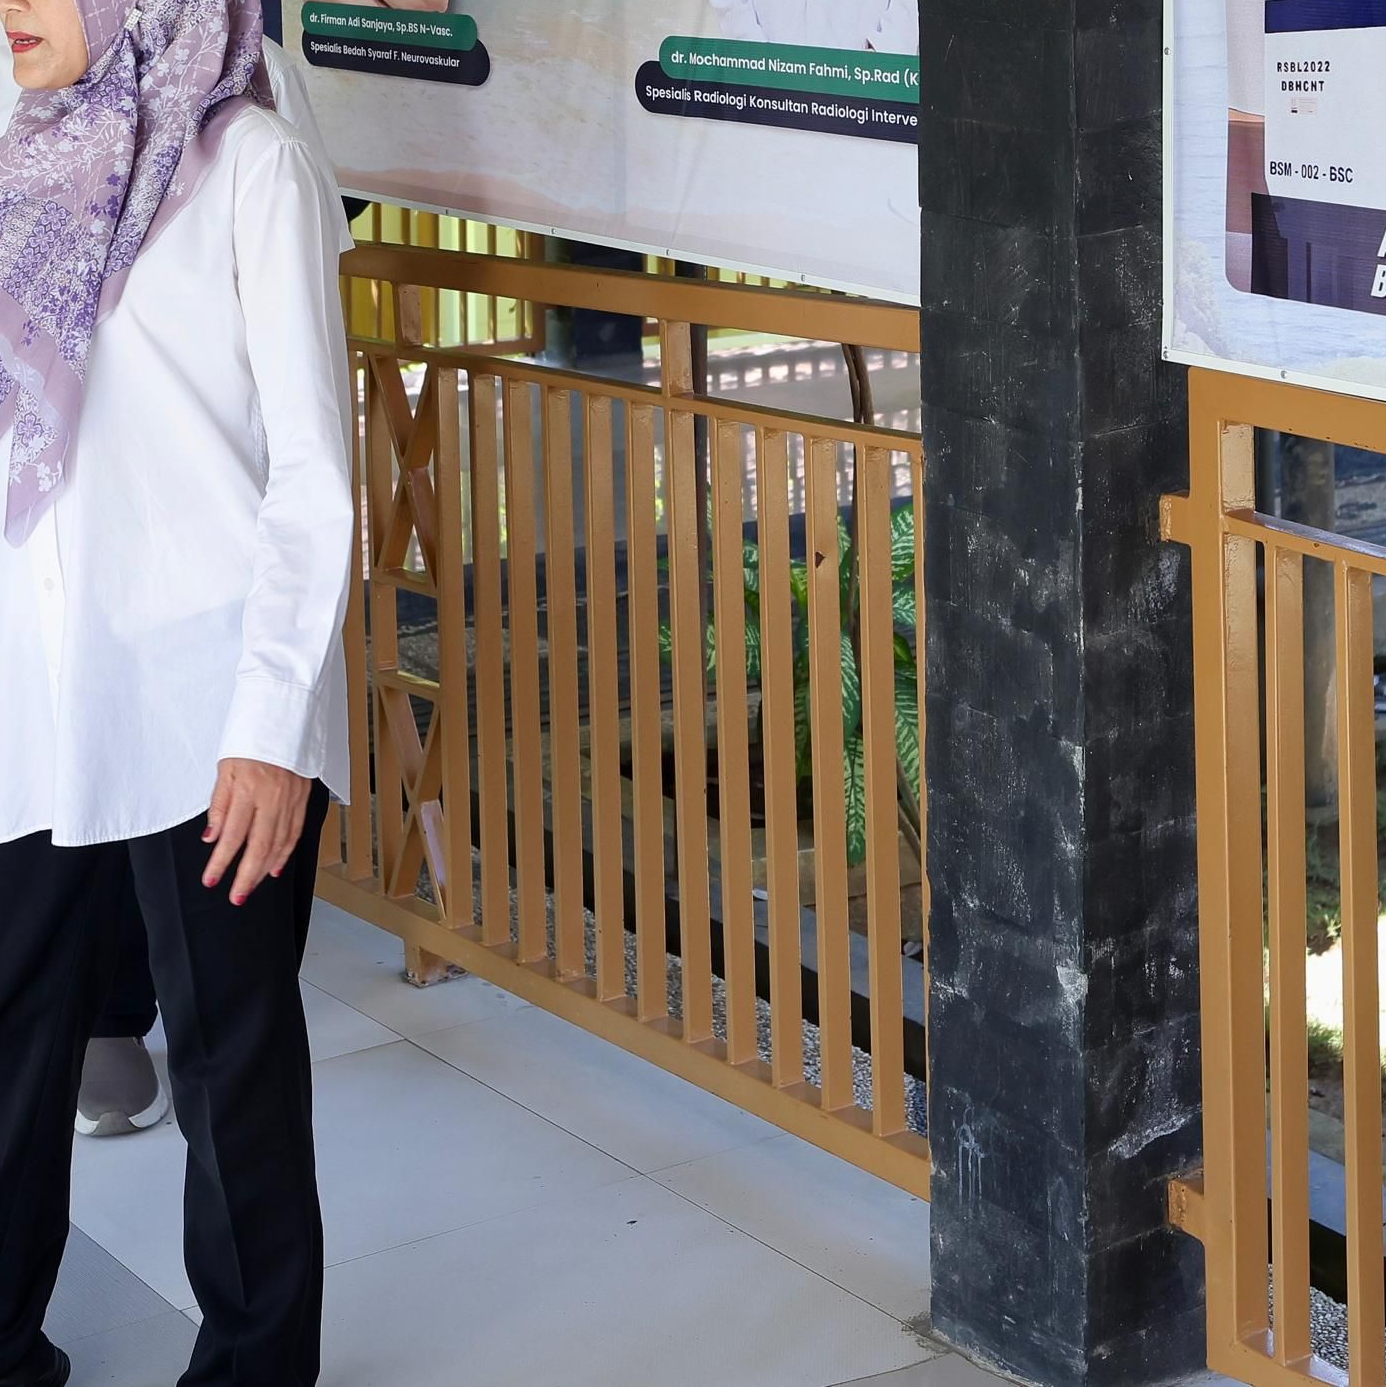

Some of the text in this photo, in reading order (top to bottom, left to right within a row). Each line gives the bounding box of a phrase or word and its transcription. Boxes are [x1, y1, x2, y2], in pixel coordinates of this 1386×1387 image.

[310, 14, 452, 36] dr. Firman Adi Sanjaya, Sp.BS N-Vasc.
[311, 42, 459, 67] Spesialis Bedah Syaraf F. Neurovaskular
[672, 51, 686, 63] dr.
[690, 53, 765, 70] Mochammad
[769, 59, 806, 74] Nizam
[810, 63, 851, 80] Fahmi,
[854, 67, 899, 84] Sp.Rad
[1277, 61, 1329, 72] RSBL2022
[646, 86, 691, 101] Spesialis
[694, 91, 746, 109] Radiologi
[750, 96, 808, 113] Konsultan
[812, 103, 868, 124] Radiologi
[1270, 161, 1291, 176] BSM
[1302, 165, 1318, 179] 002
[1330, 166, 1352, 183] BSC
